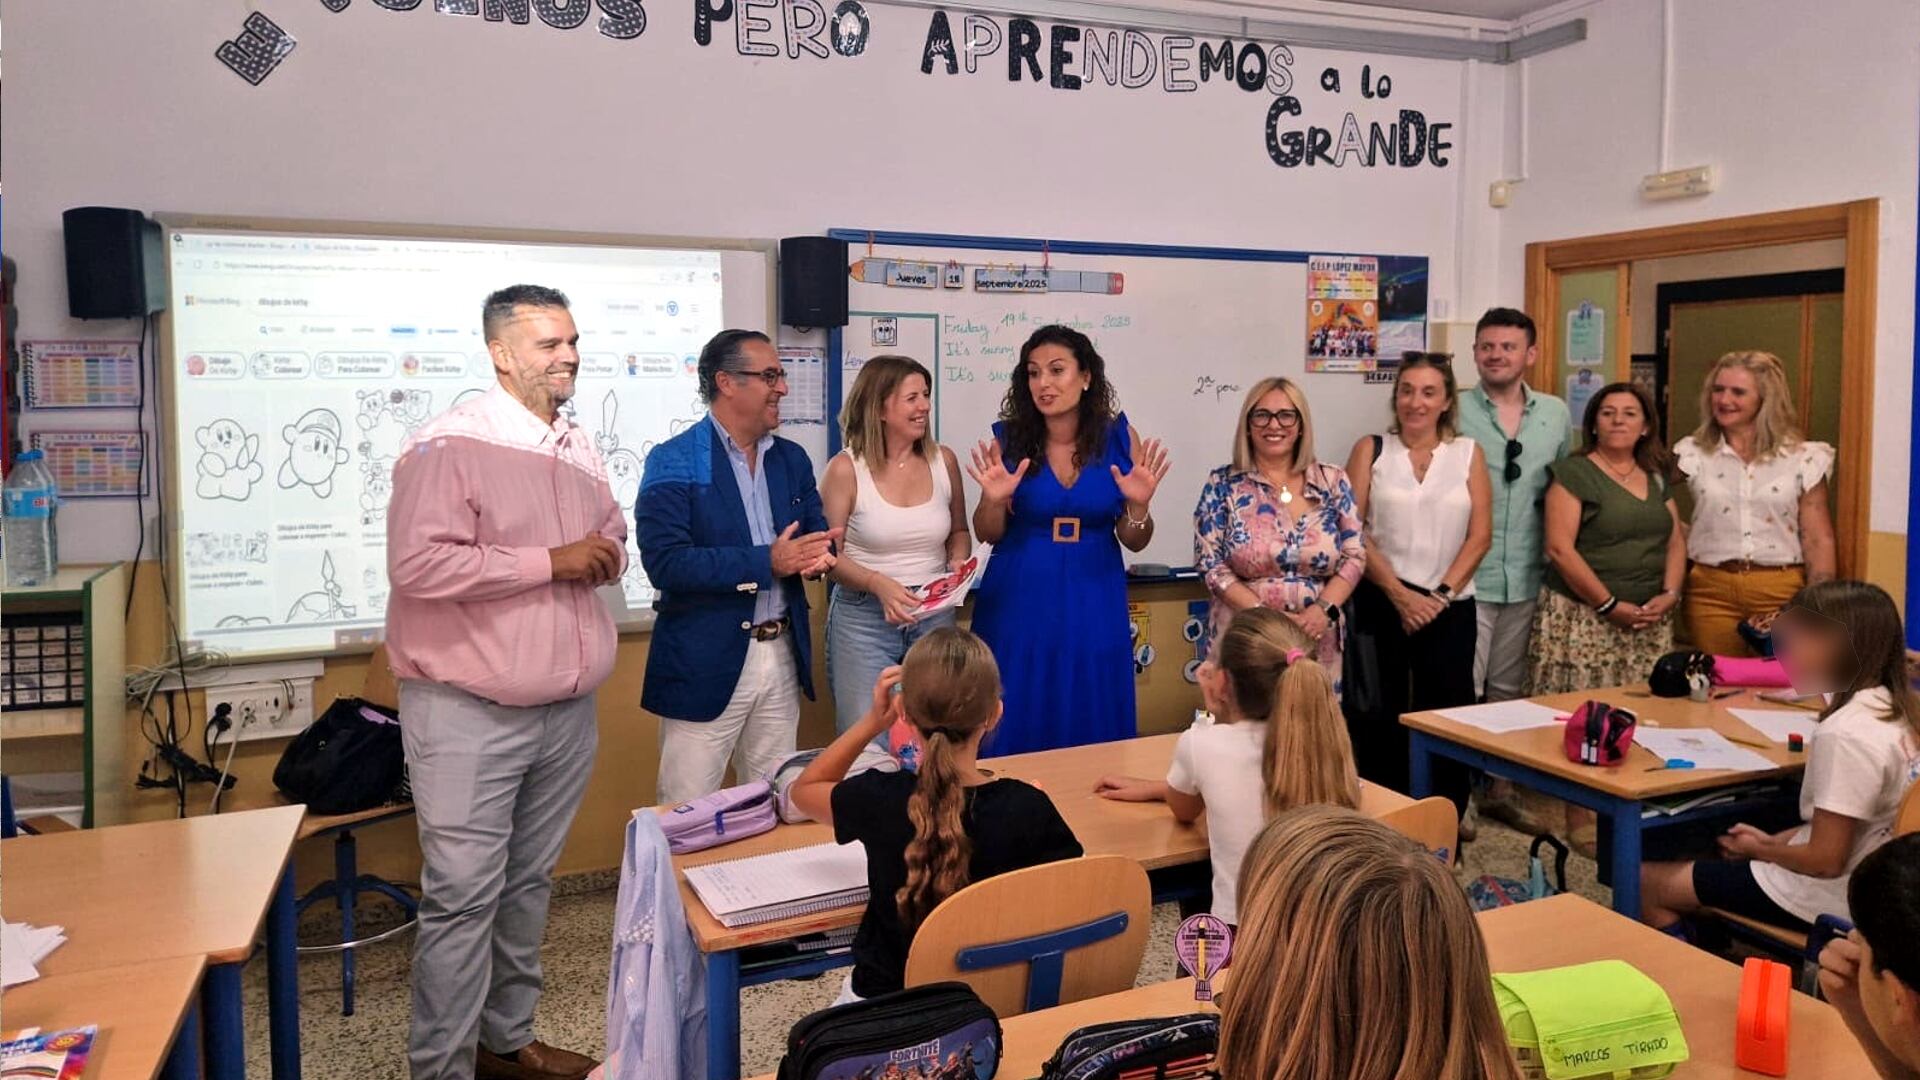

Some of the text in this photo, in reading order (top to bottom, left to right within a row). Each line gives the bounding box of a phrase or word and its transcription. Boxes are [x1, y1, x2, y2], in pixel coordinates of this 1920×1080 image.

[694, 0, 869, 58] PERO
[921, 11, 1293, 95] APRENDEMOS
[1320, 67, 1341, 93] a
[1361, 65, 1391, 98] lo
[1266, 95, 1452, 168] GRANDE
[890, 1039, 939, 1063] FORTNITE
[1562, 1047, 1610, 1067] MARCOS
